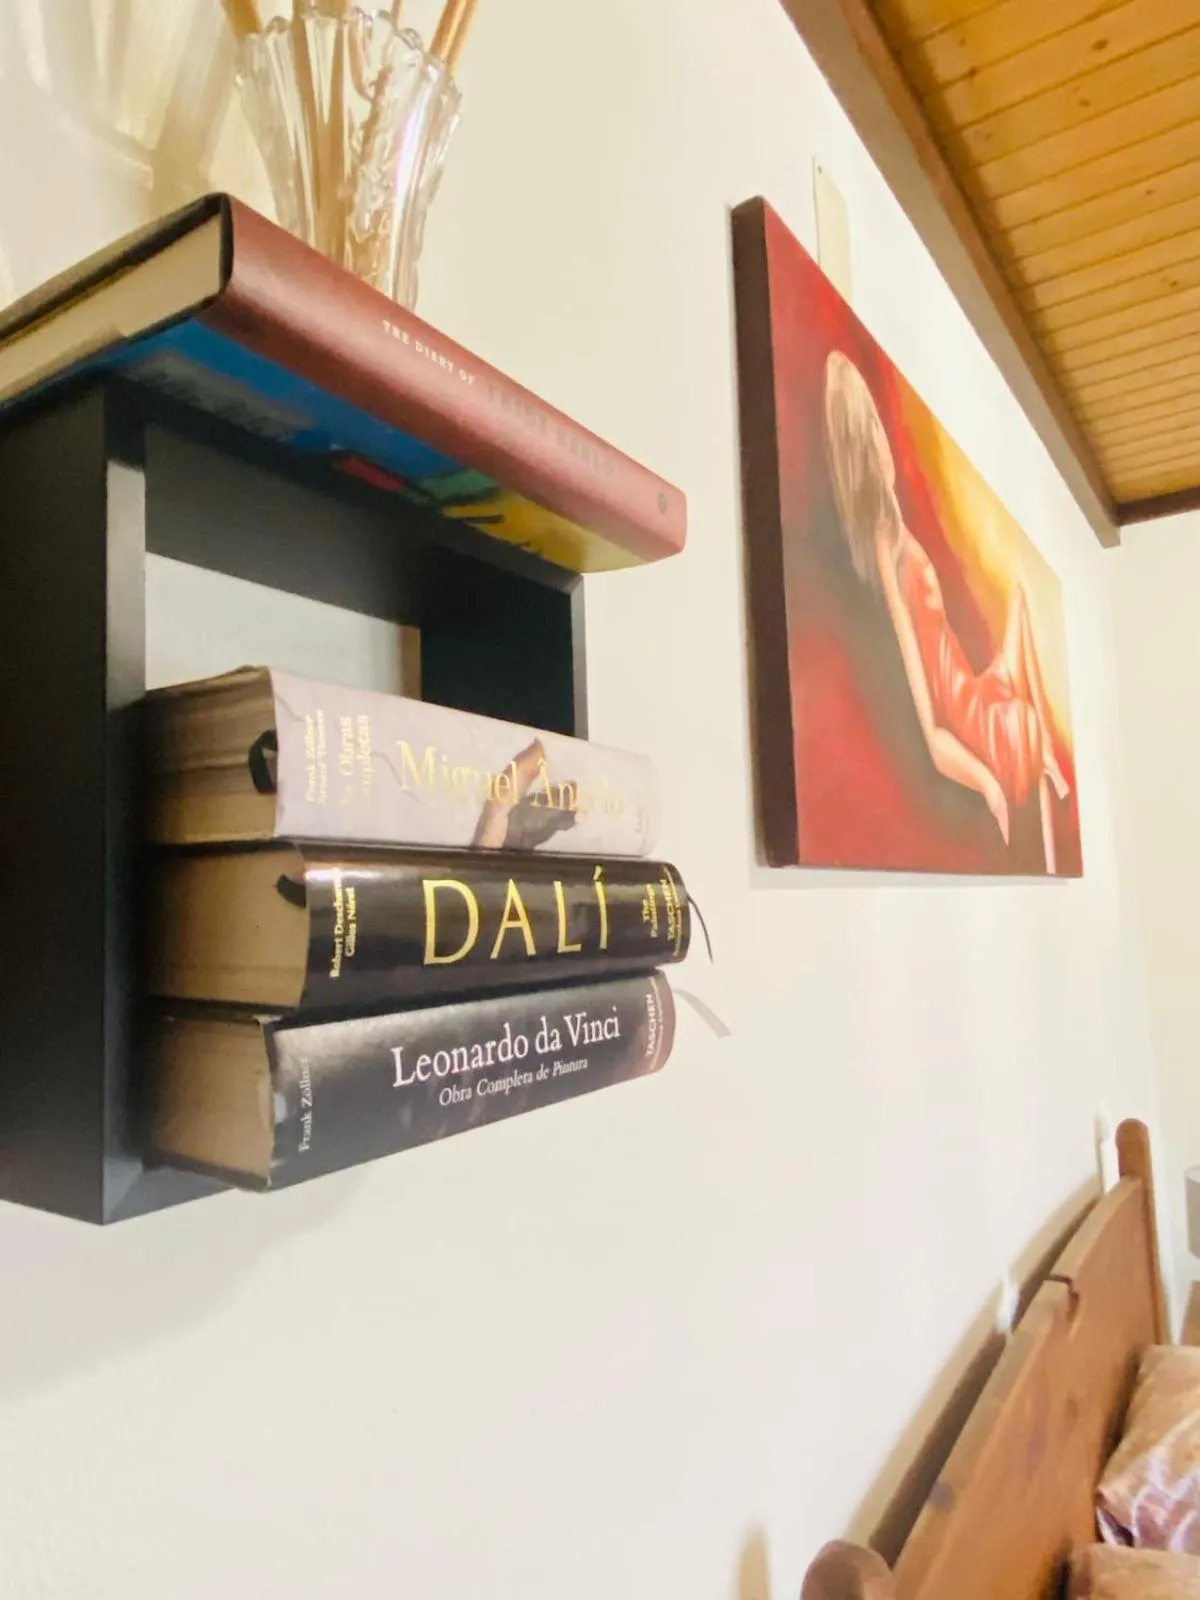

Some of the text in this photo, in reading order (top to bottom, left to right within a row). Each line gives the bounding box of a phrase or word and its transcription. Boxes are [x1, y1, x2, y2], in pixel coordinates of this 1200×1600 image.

[383, 319, 410, 346] THE
[415, 339, 454, 373] DIARY
[458, 368, 474, 386] OF
[396, 739, 519, 810] Miguel
[529, 756, 626, 818] Ânlo
[422, 864, 608, 965] DALÍ
[390, 1021, 529, 1088] Leonardo
[535, 1015, 562, 1055] da
[563, 1005, 621, 1048] Vinci
[438, 1057, 589, 1107] Obra Completa de Pintura
[298, 1111, 313, 1151] Frank
